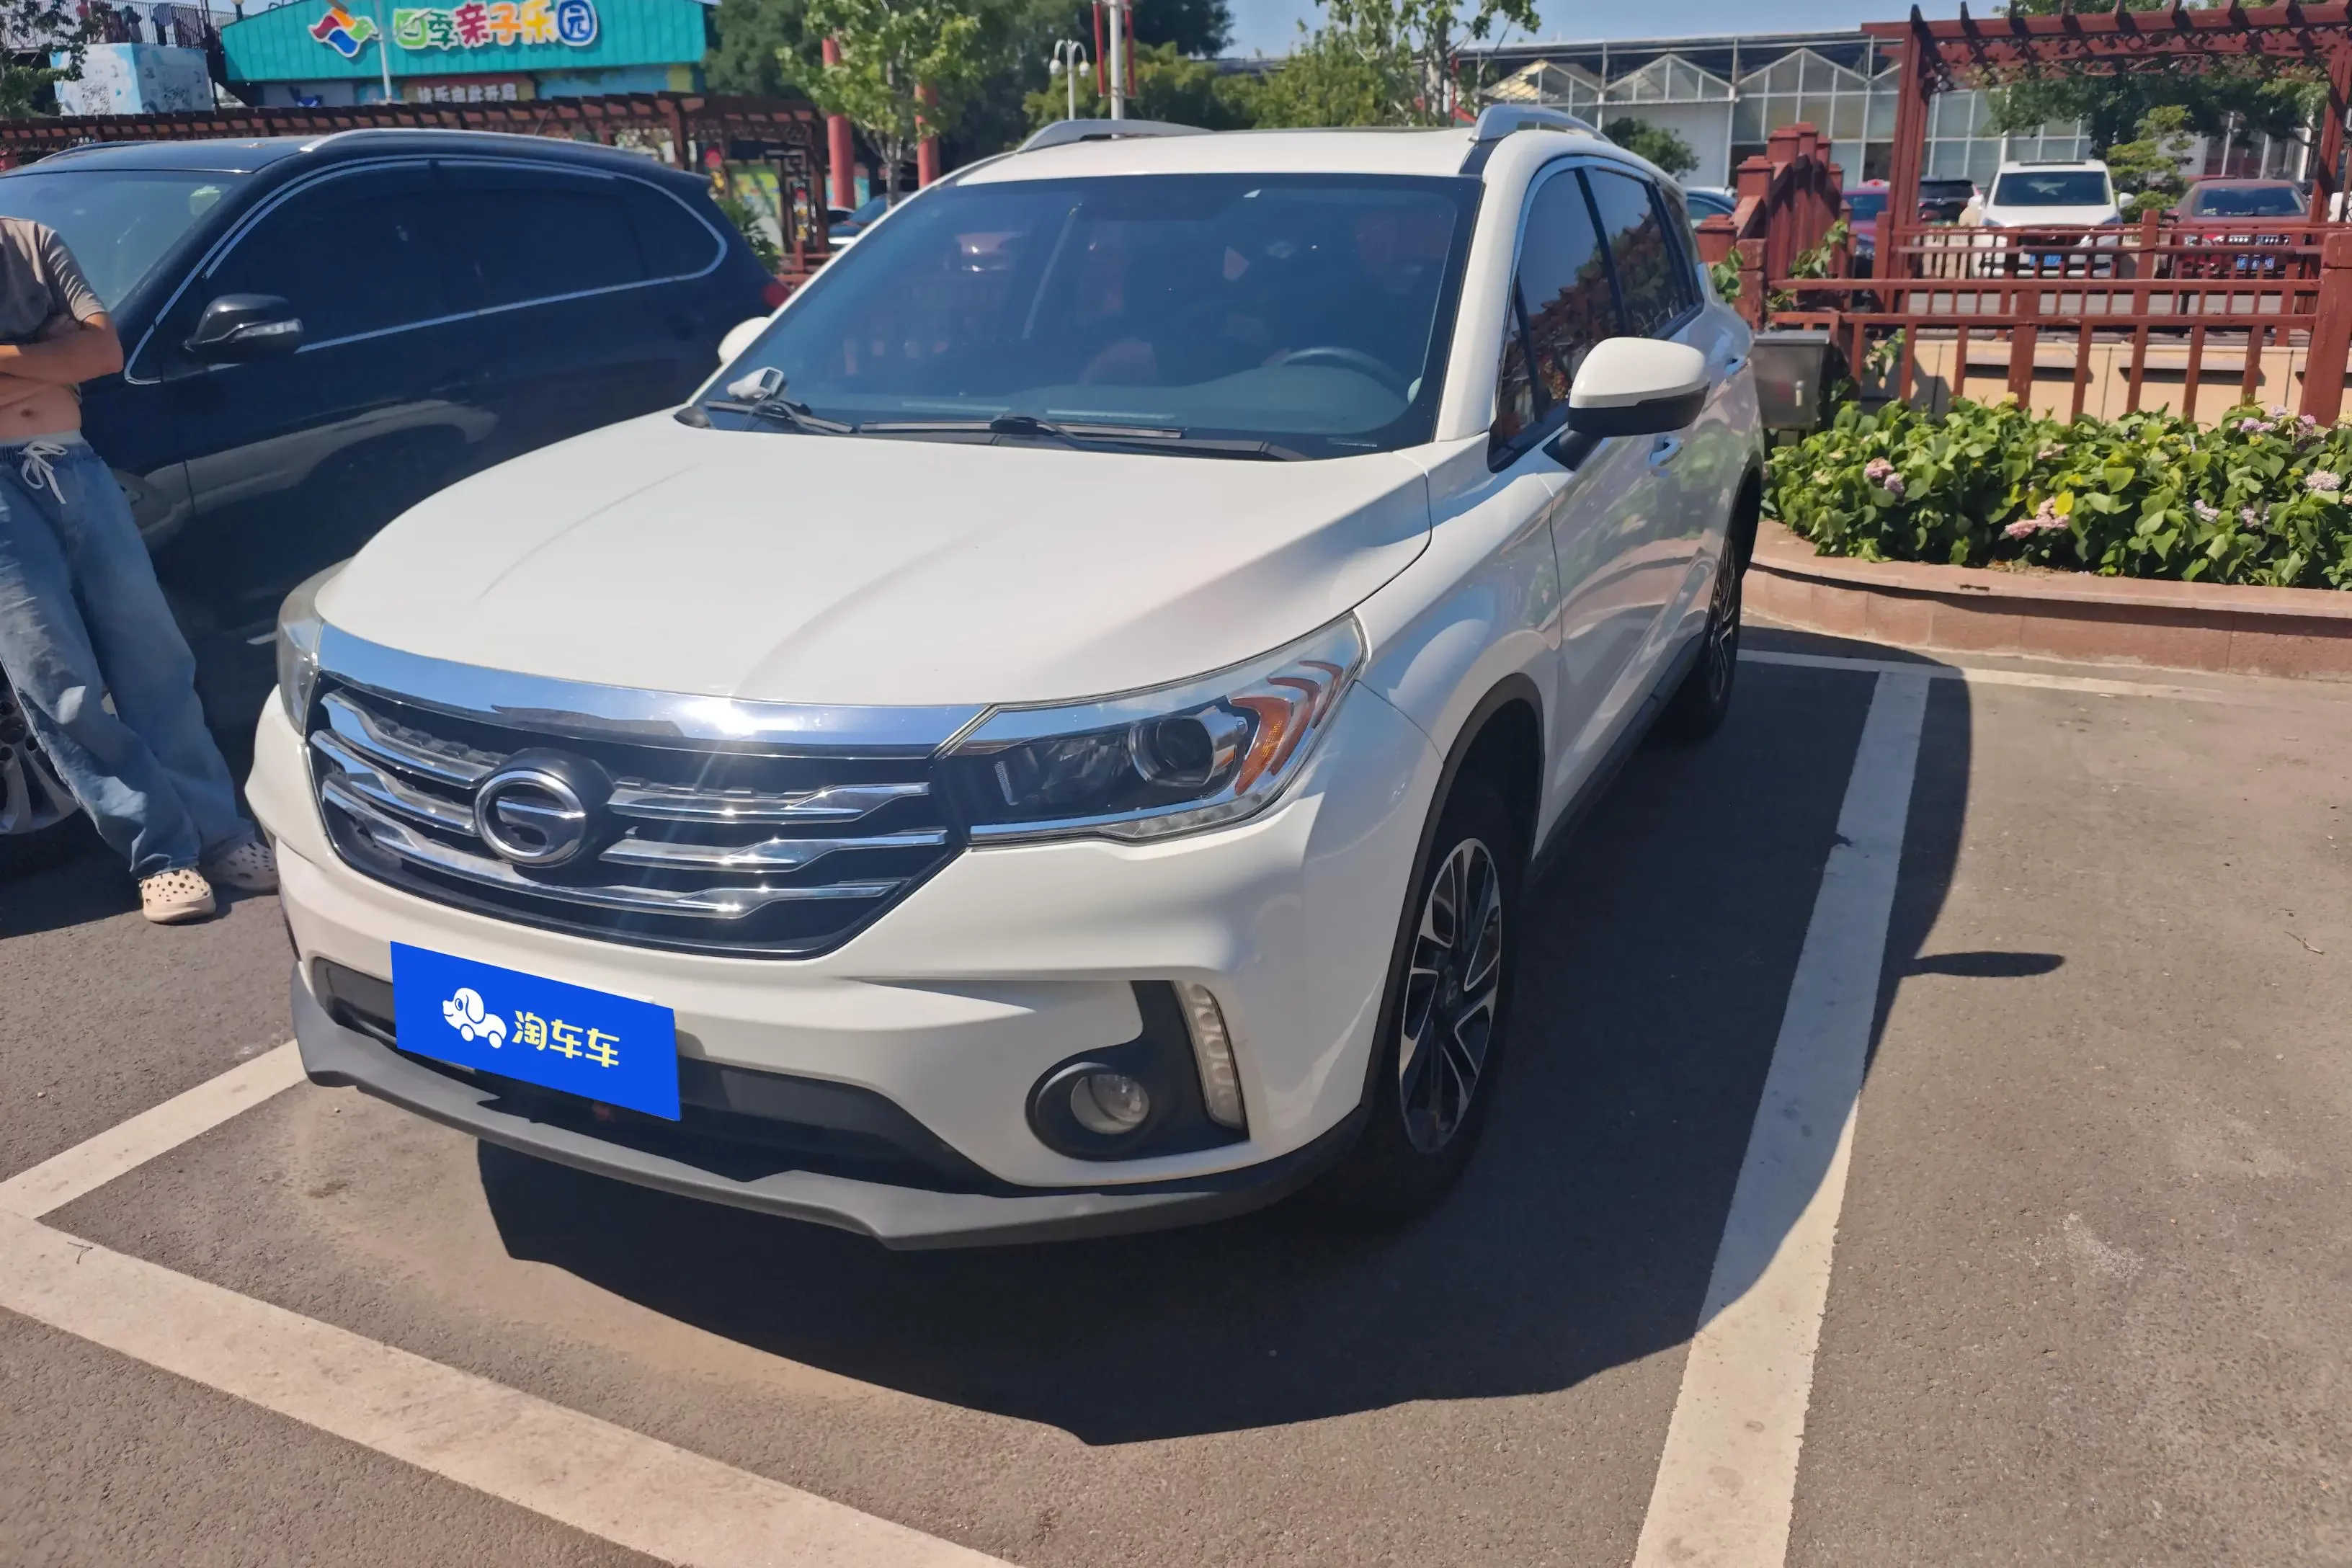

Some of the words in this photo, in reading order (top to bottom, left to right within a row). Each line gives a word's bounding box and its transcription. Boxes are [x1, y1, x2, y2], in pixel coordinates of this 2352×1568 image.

[393, 0, 597, 50] 四季亲子乐园
